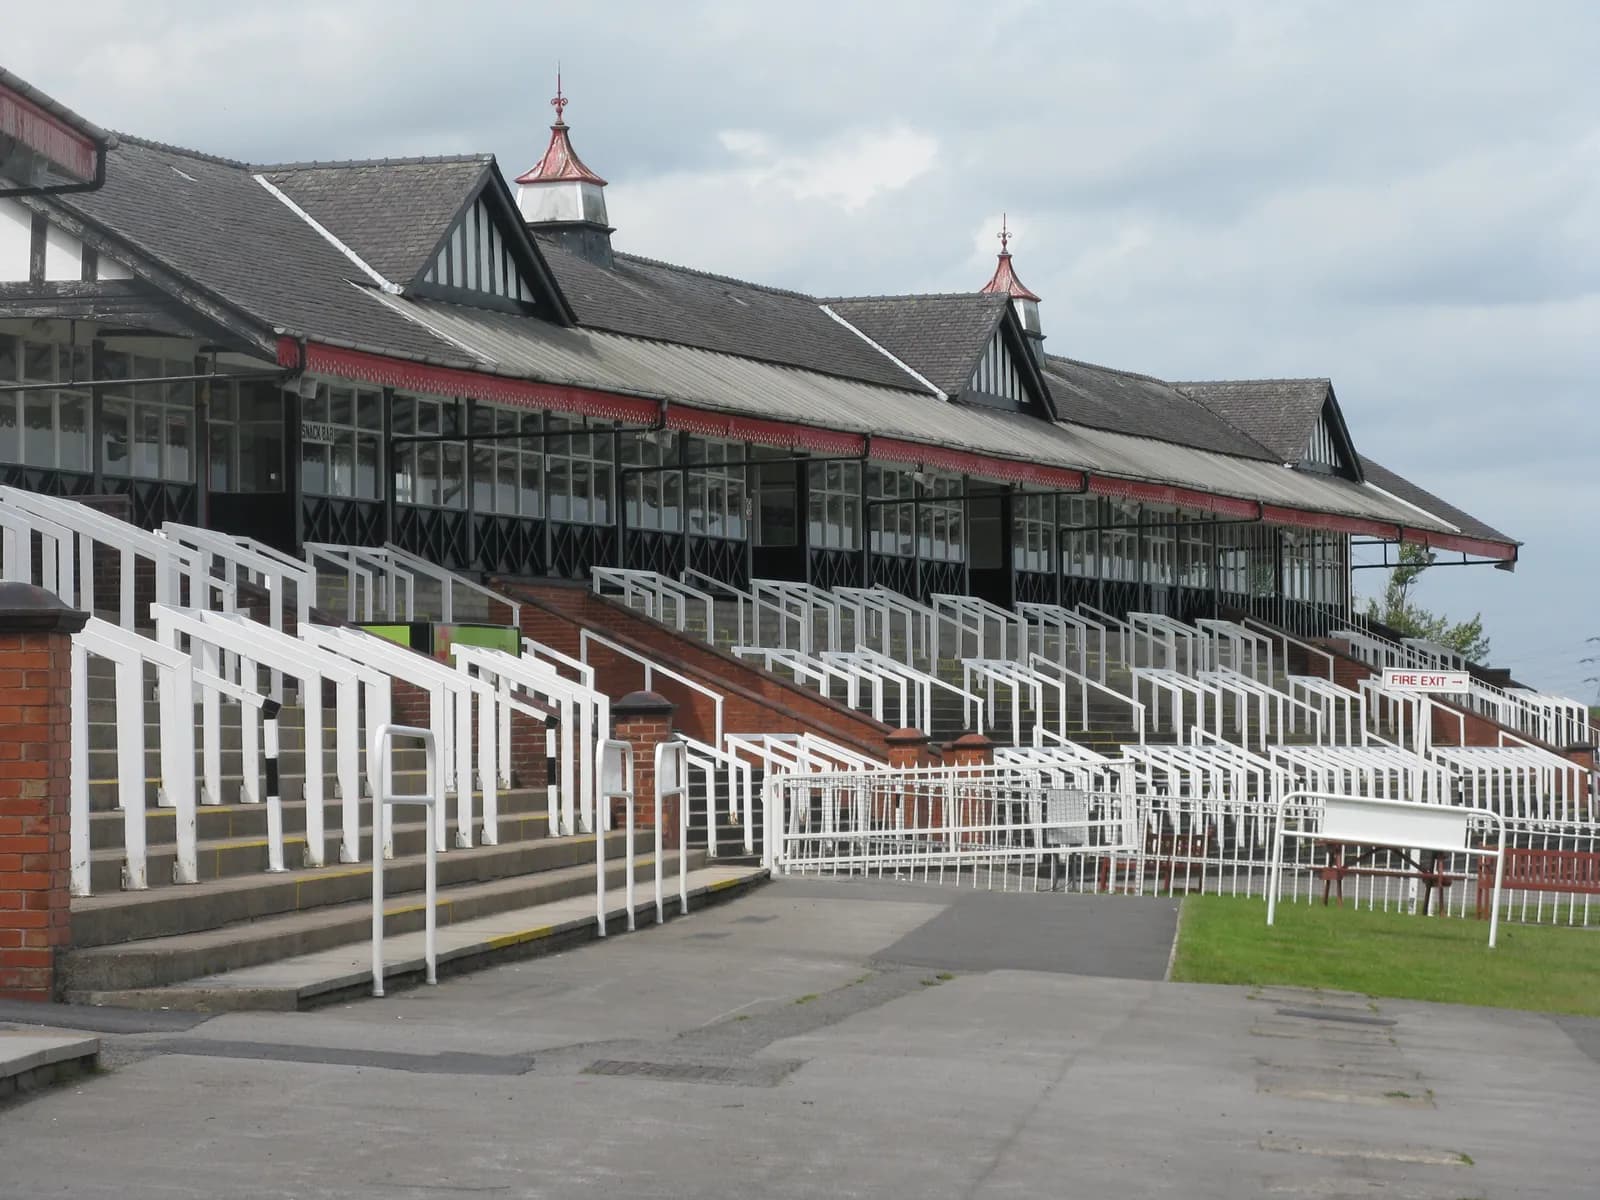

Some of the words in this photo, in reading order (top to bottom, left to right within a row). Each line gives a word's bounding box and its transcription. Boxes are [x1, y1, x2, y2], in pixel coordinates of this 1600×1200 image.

[302, 423, 321, 440] SNACK
[321, 425, 333, 442] BAR
[1391, 675, 1417, 685] FIRE
[1420, 676, 1447, 687] EXIT
